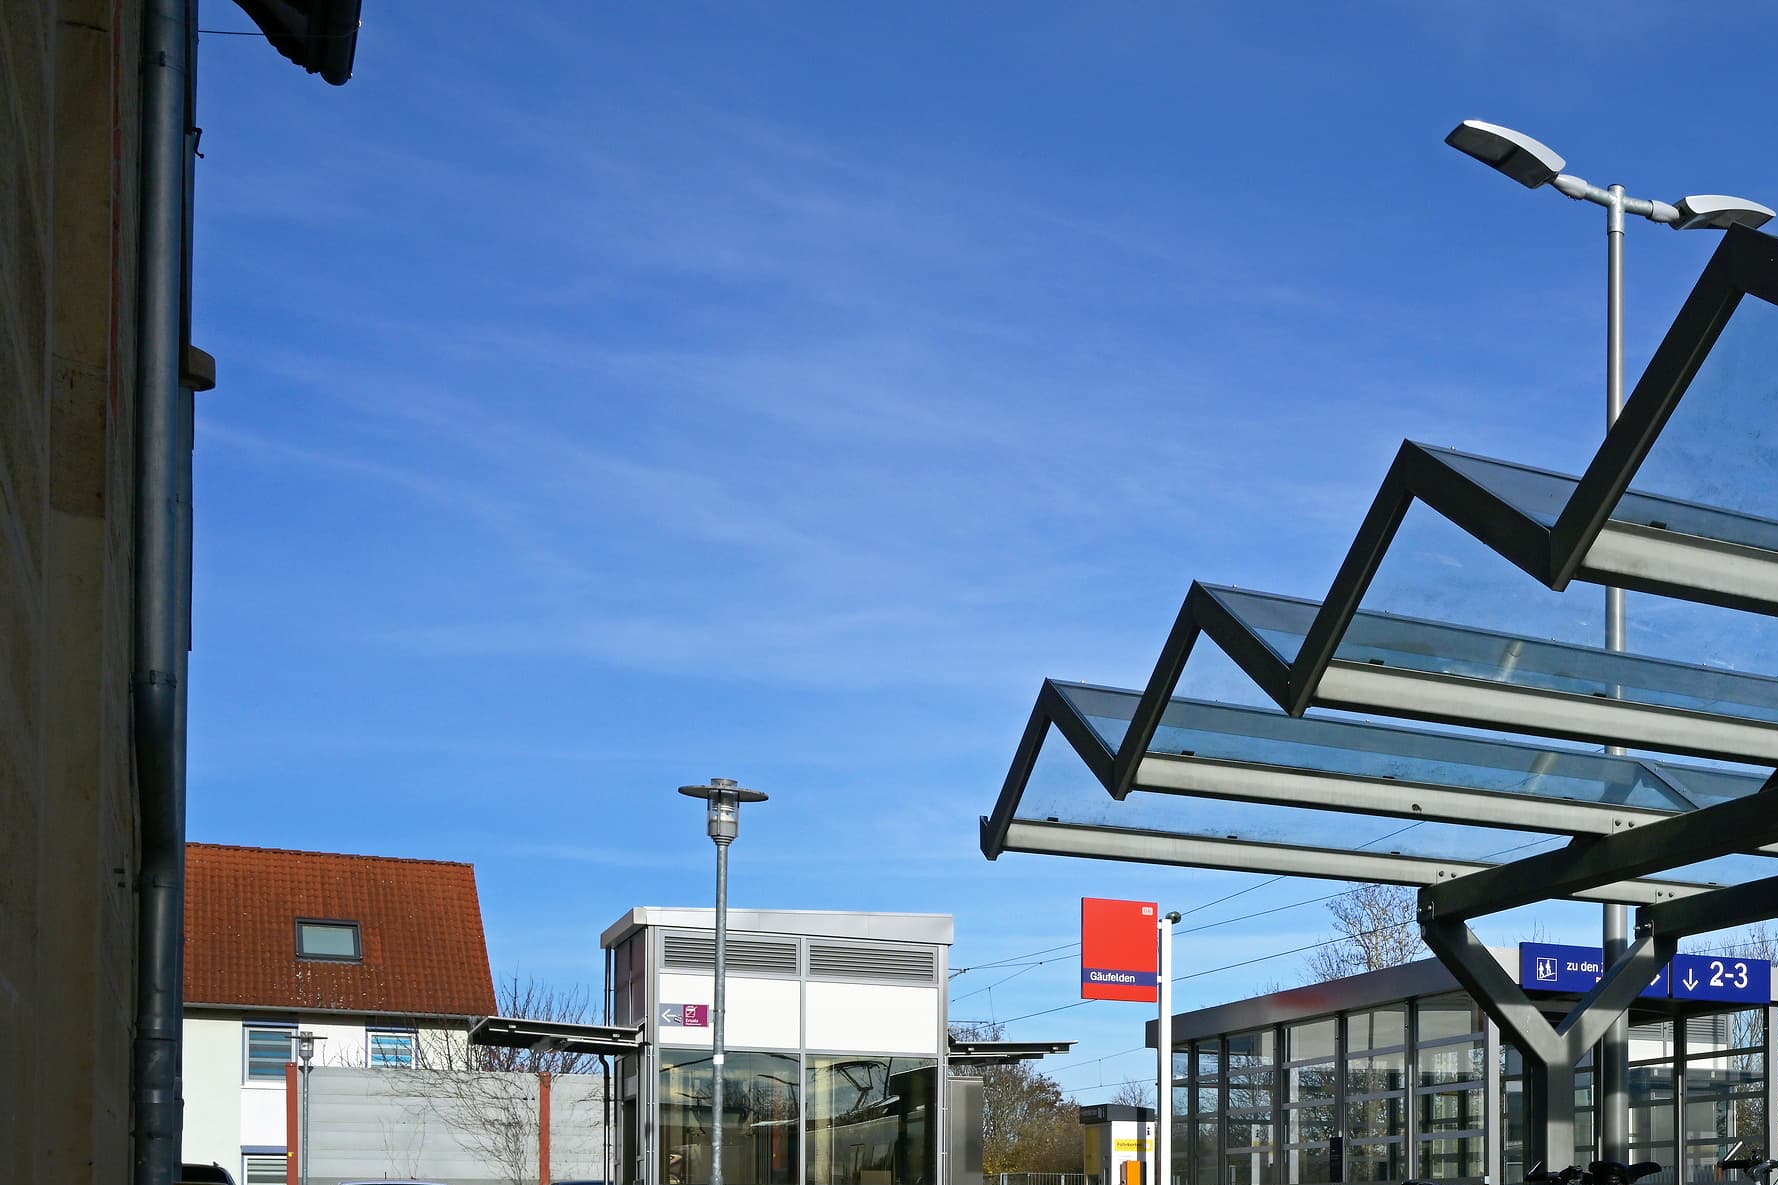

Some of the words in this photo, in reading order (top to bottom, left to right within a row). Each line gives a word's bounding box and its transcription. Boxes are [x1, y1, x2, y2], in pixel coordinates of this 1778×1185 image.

[1567, 962, 1578, 971] zu
[1581, 961, 1599, 973] den
[1090, 971, 1136, 983] Gäufelden
[1709, 960, 1748, 989] 2-3
